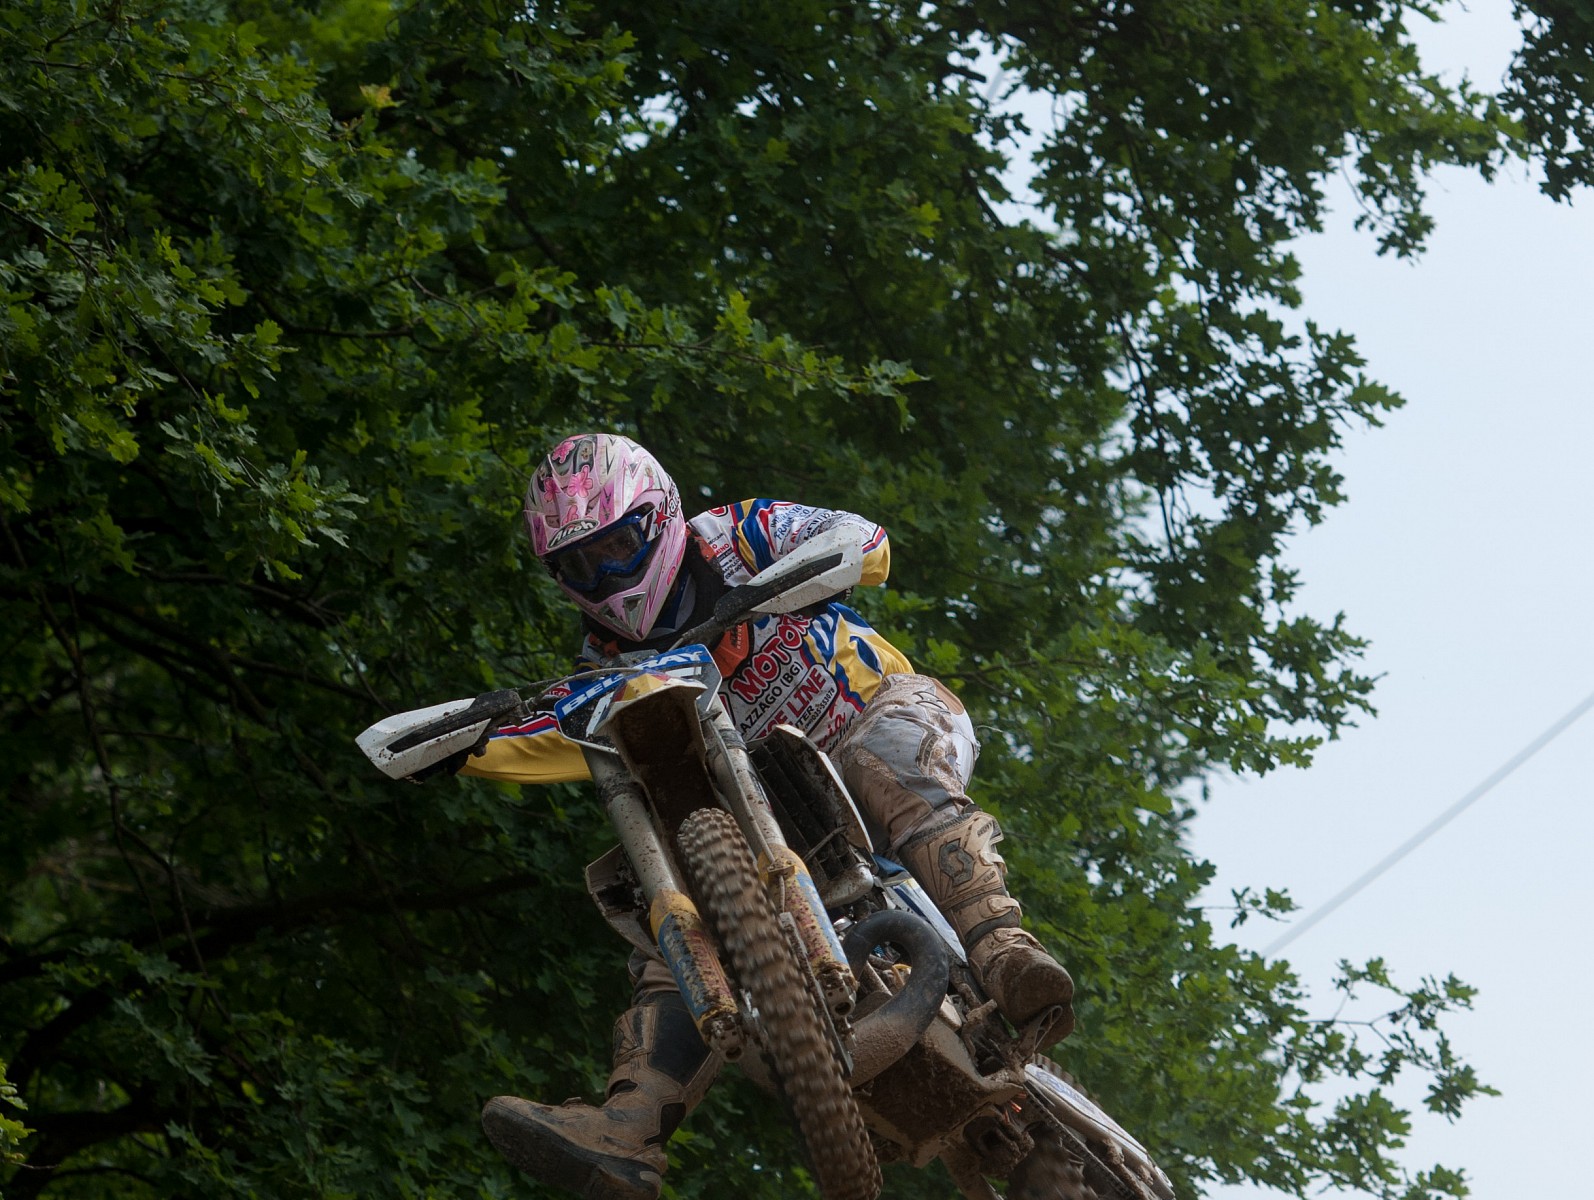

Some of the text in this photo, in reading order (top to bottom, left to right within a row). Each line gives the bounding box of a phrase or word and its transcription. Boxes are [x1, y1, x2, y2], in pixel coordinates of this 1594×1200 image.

[550, 521, 594, 546] Airoh
[731, 613, 814, 702] MOTOR
[738, 661, 804, 733] AZZAGO (BG)
[786, 668, 827, 718] LINE
